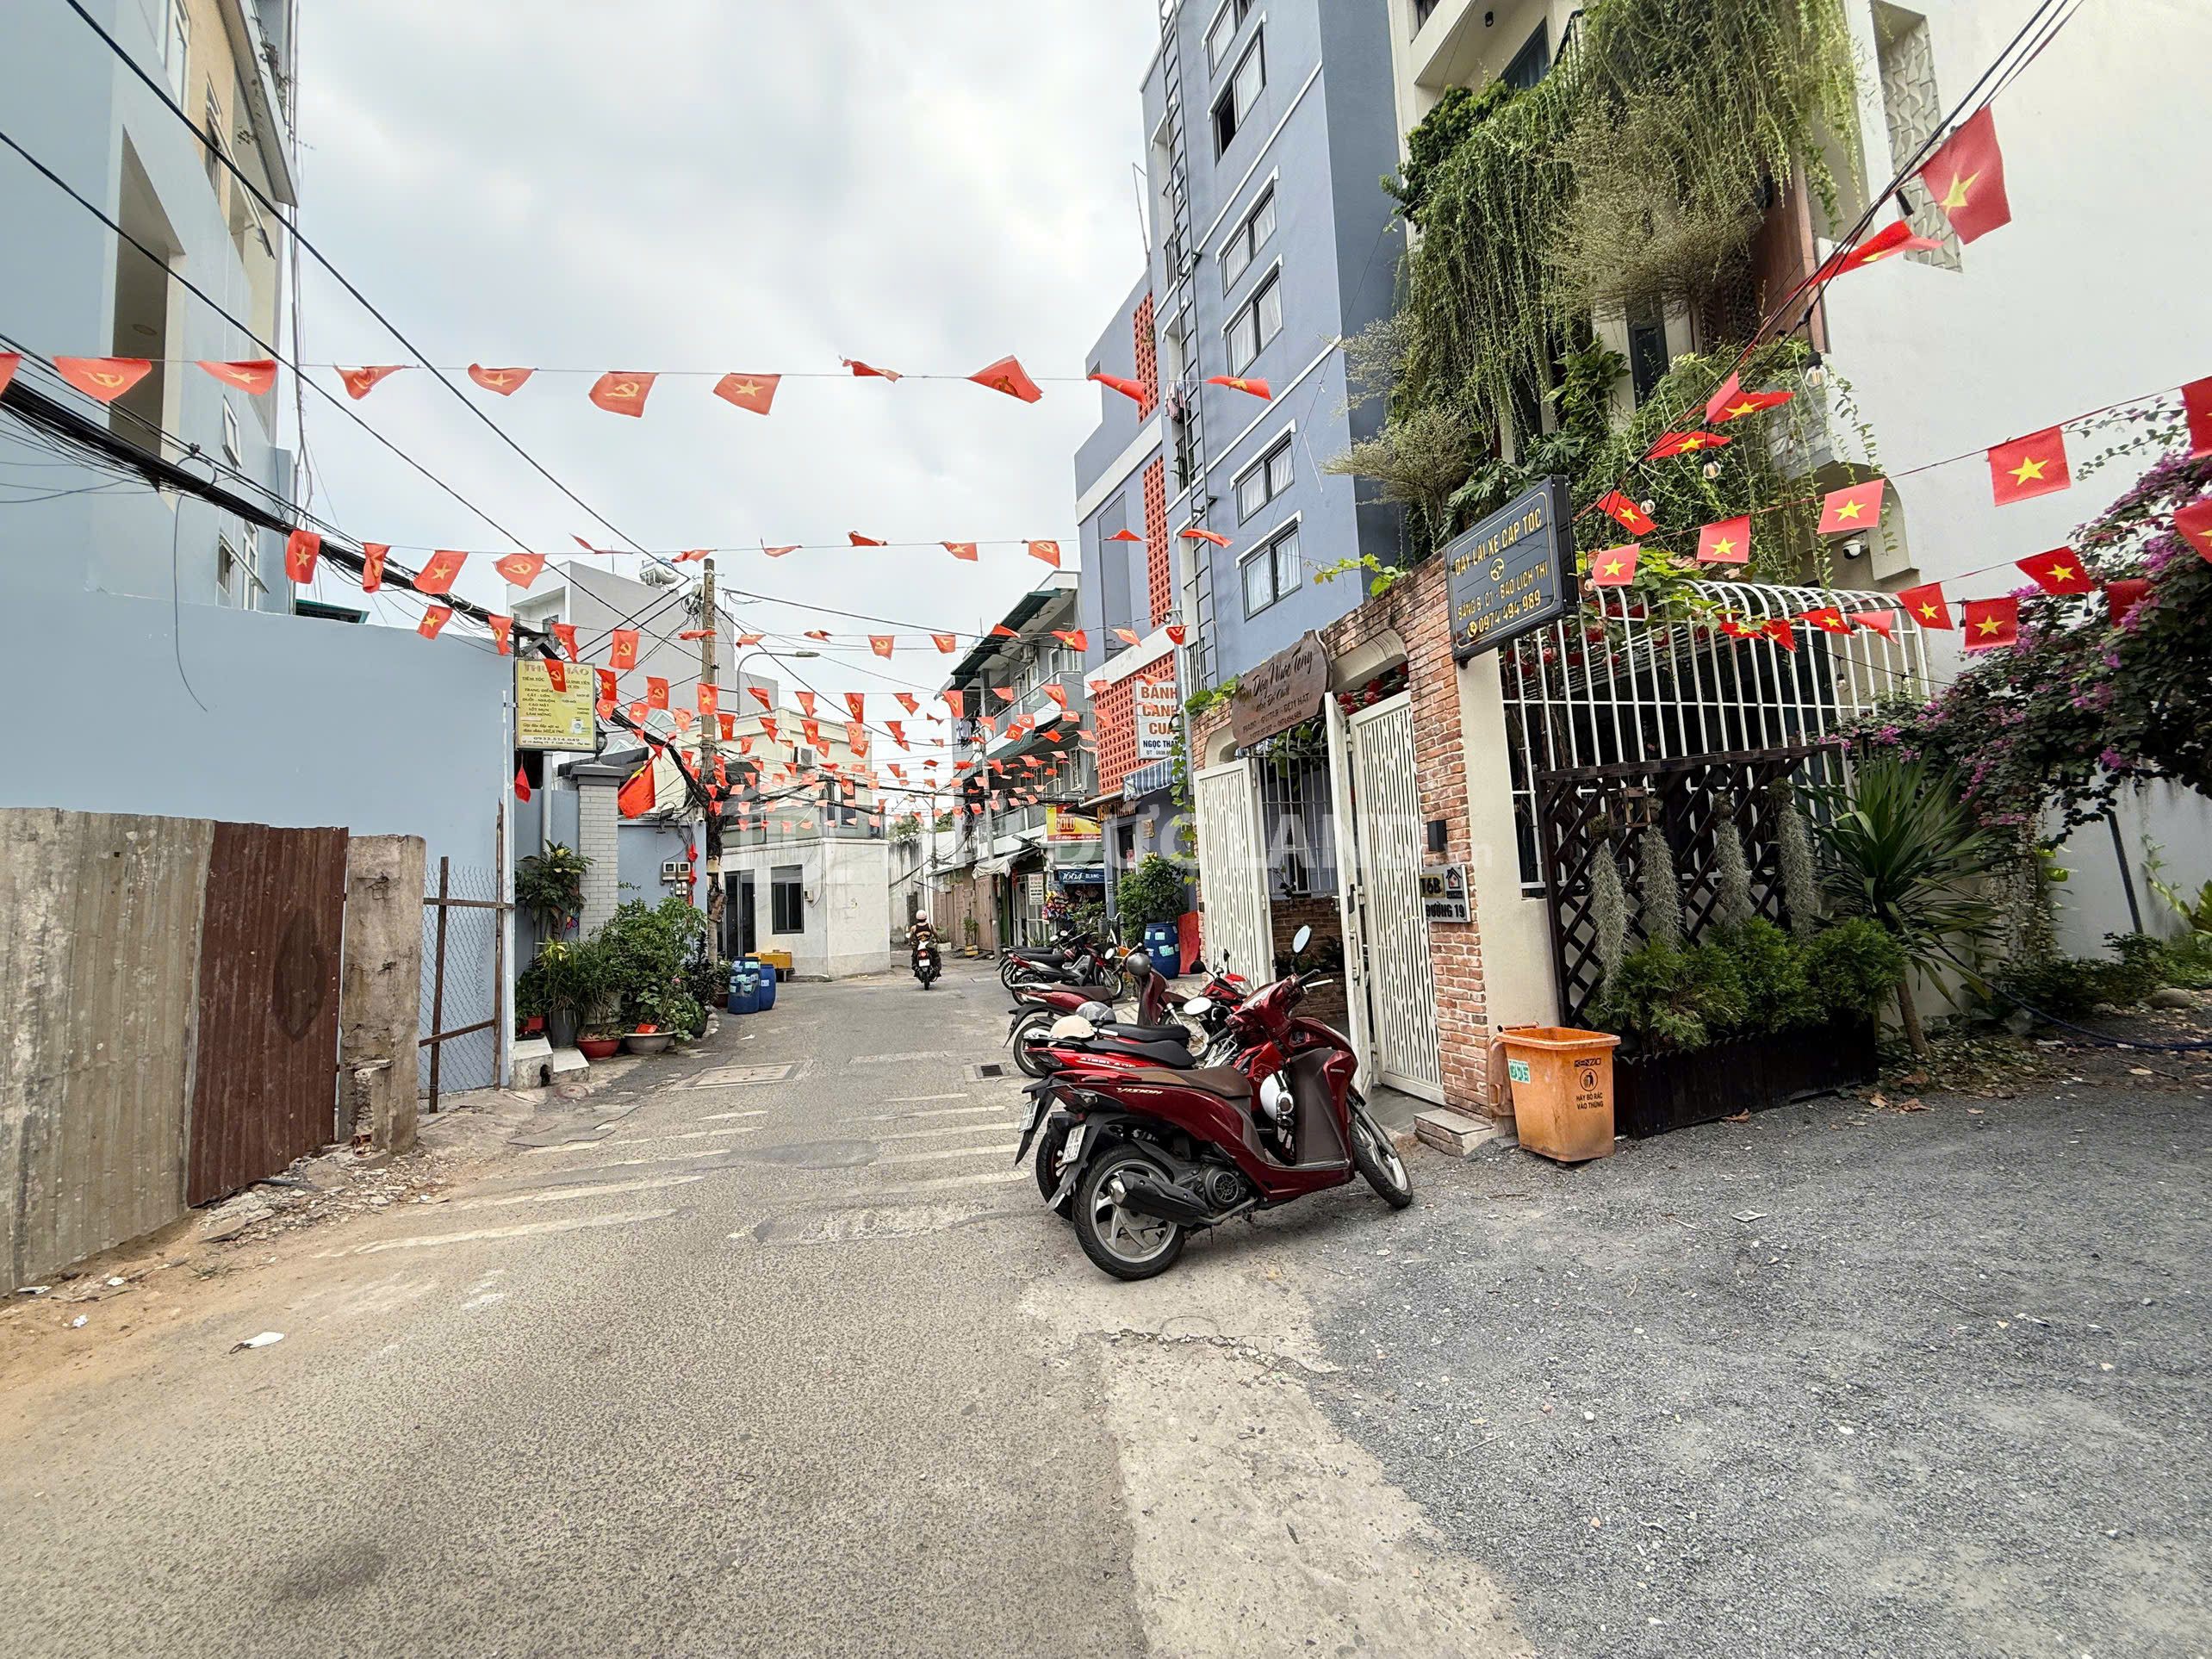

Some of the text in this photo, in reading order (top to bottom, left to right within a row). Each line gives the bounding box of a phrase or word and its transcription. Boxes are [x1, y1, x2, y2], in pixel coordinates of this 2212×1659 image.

[1488, 534, 1500, 556] XE
[1535, 561, 1548, 580] THI
[1478, 589, 1541, 633] 0974 494 989
[1141, 685, 1177, 699] BÁNH
[1143, 740, 1161, 749] NGỌC
[1055, 817, 1075, 830] GOLD
[1454, 904, 1465, 917] 19
